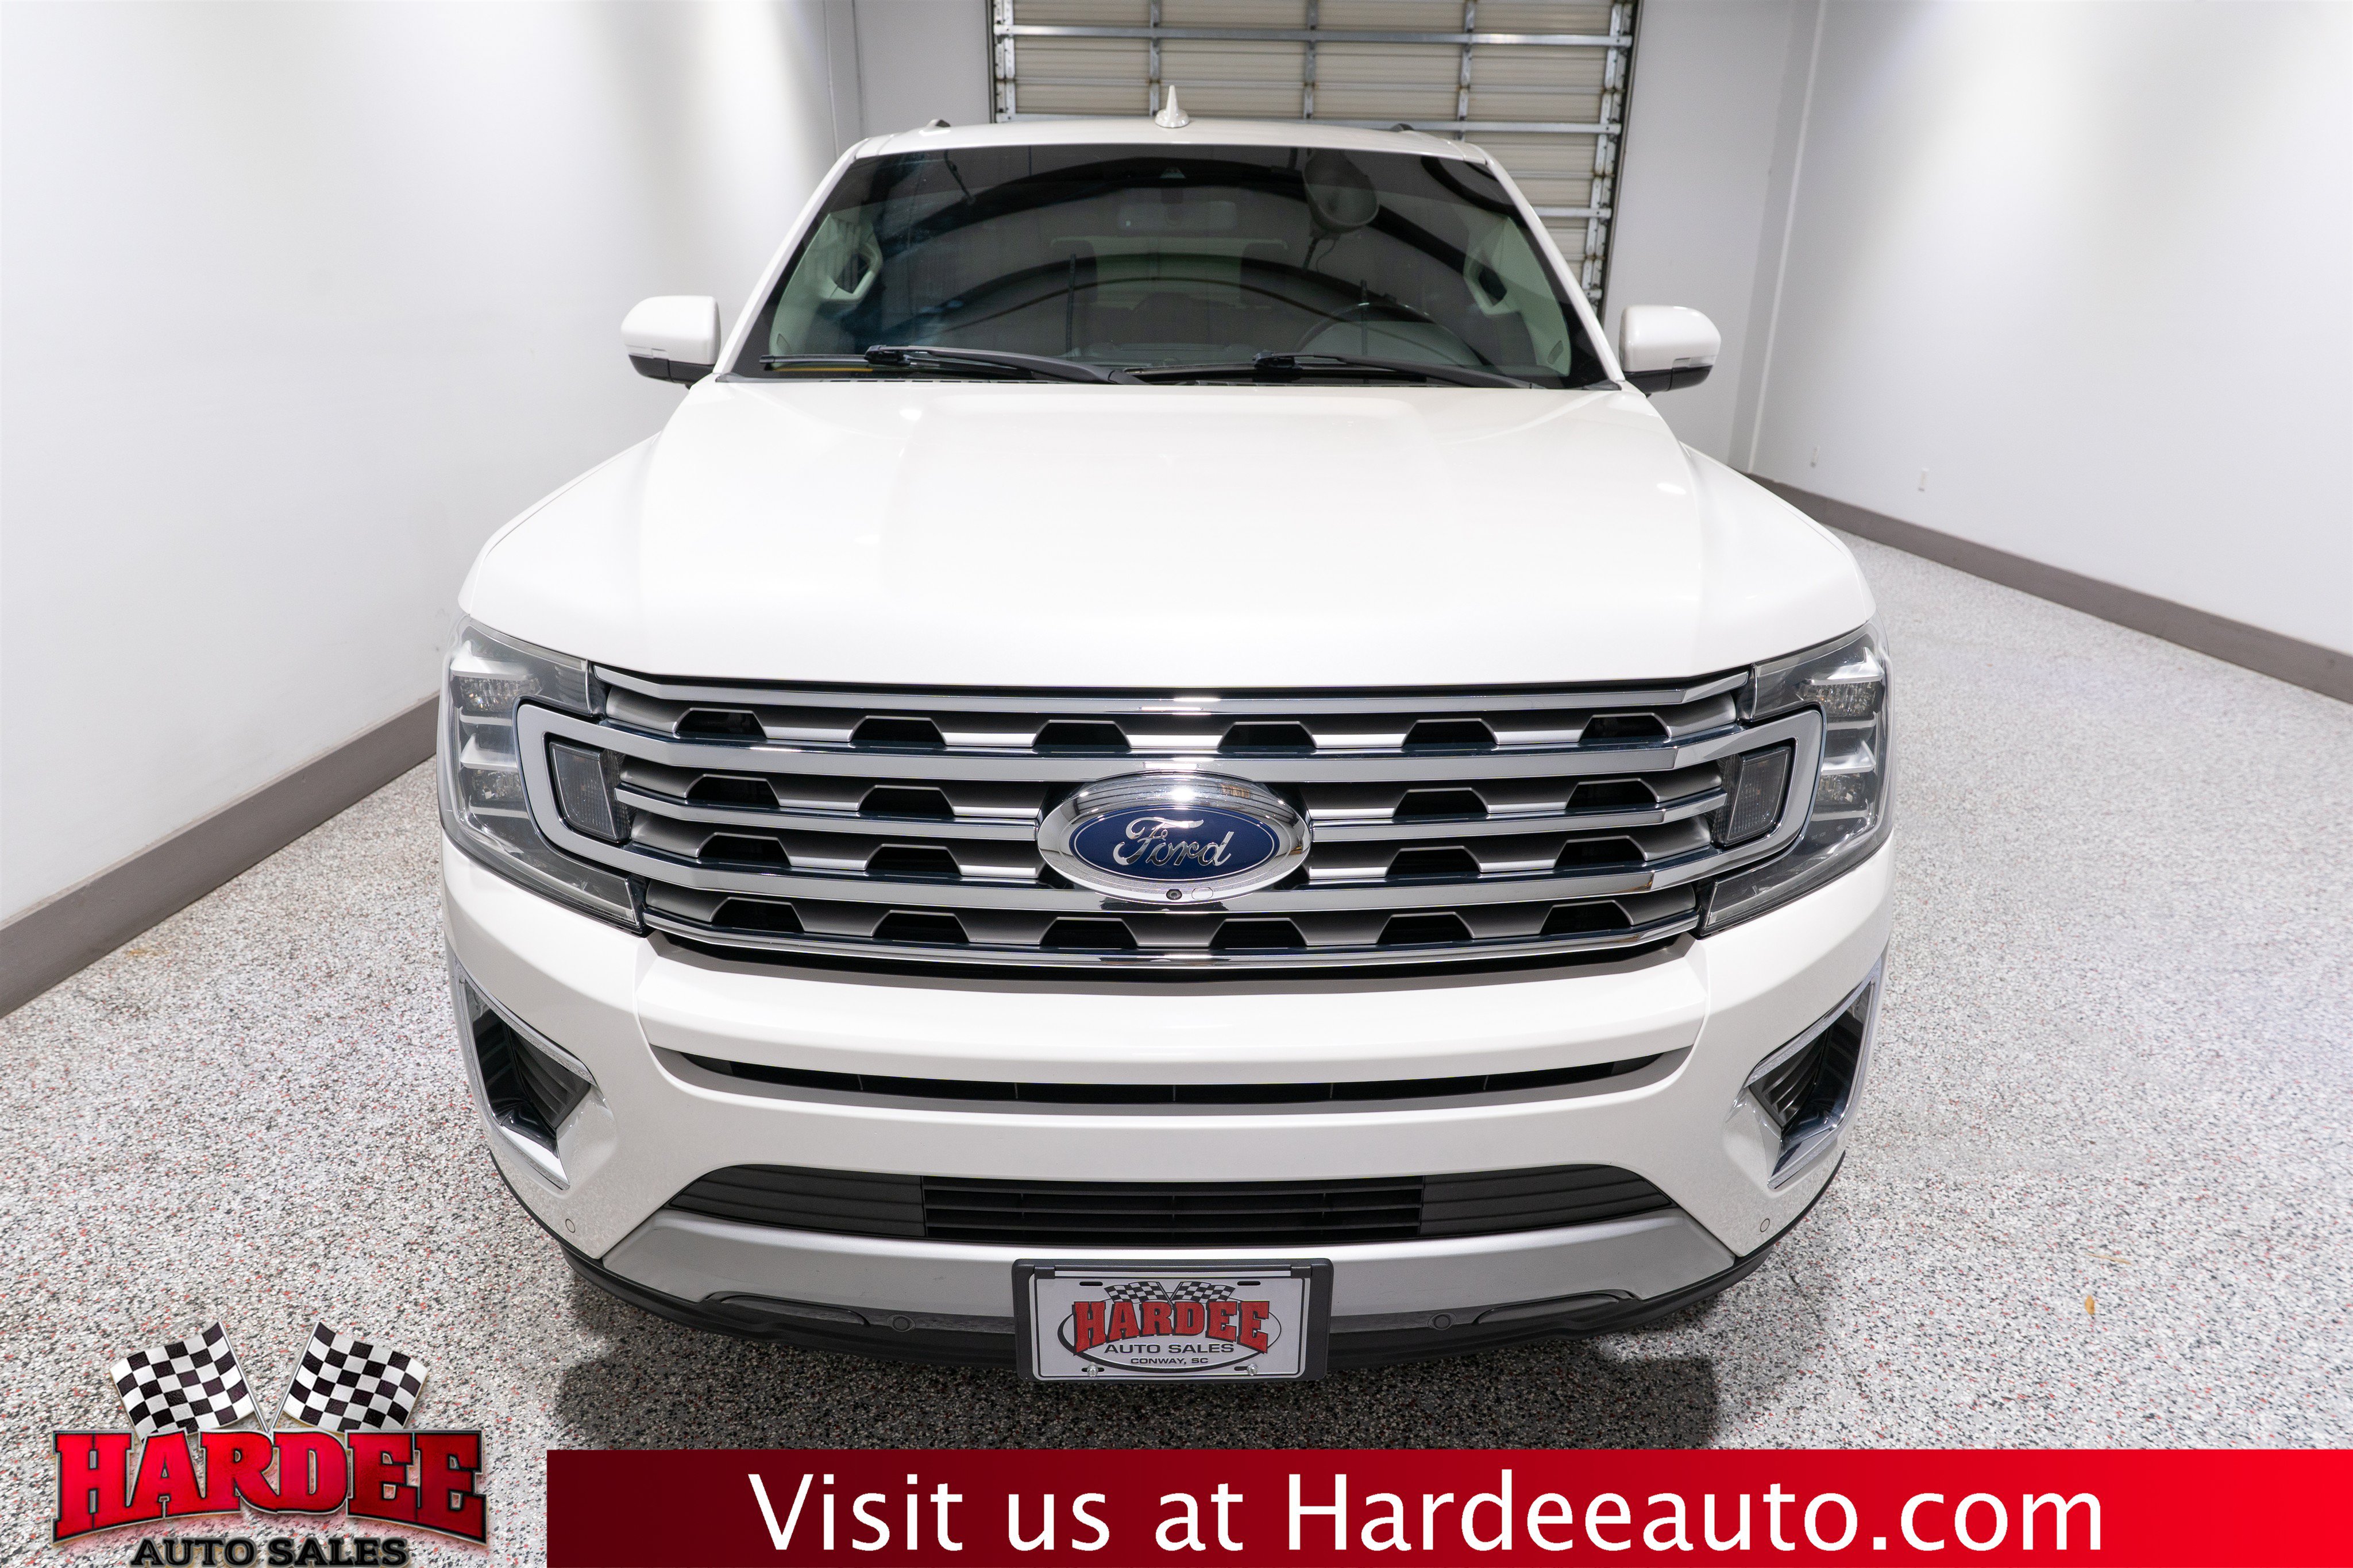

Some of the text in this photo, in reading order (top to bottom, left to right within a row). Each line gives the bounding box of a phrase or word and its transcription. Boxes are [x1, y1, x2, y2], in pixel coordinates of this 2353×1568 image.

[1113, 817, 1235, 867] Ford
[1073, 1301, 1270, 1355] HARDEE
[1104, 1343, 1234, 1354] AUTO SALES
